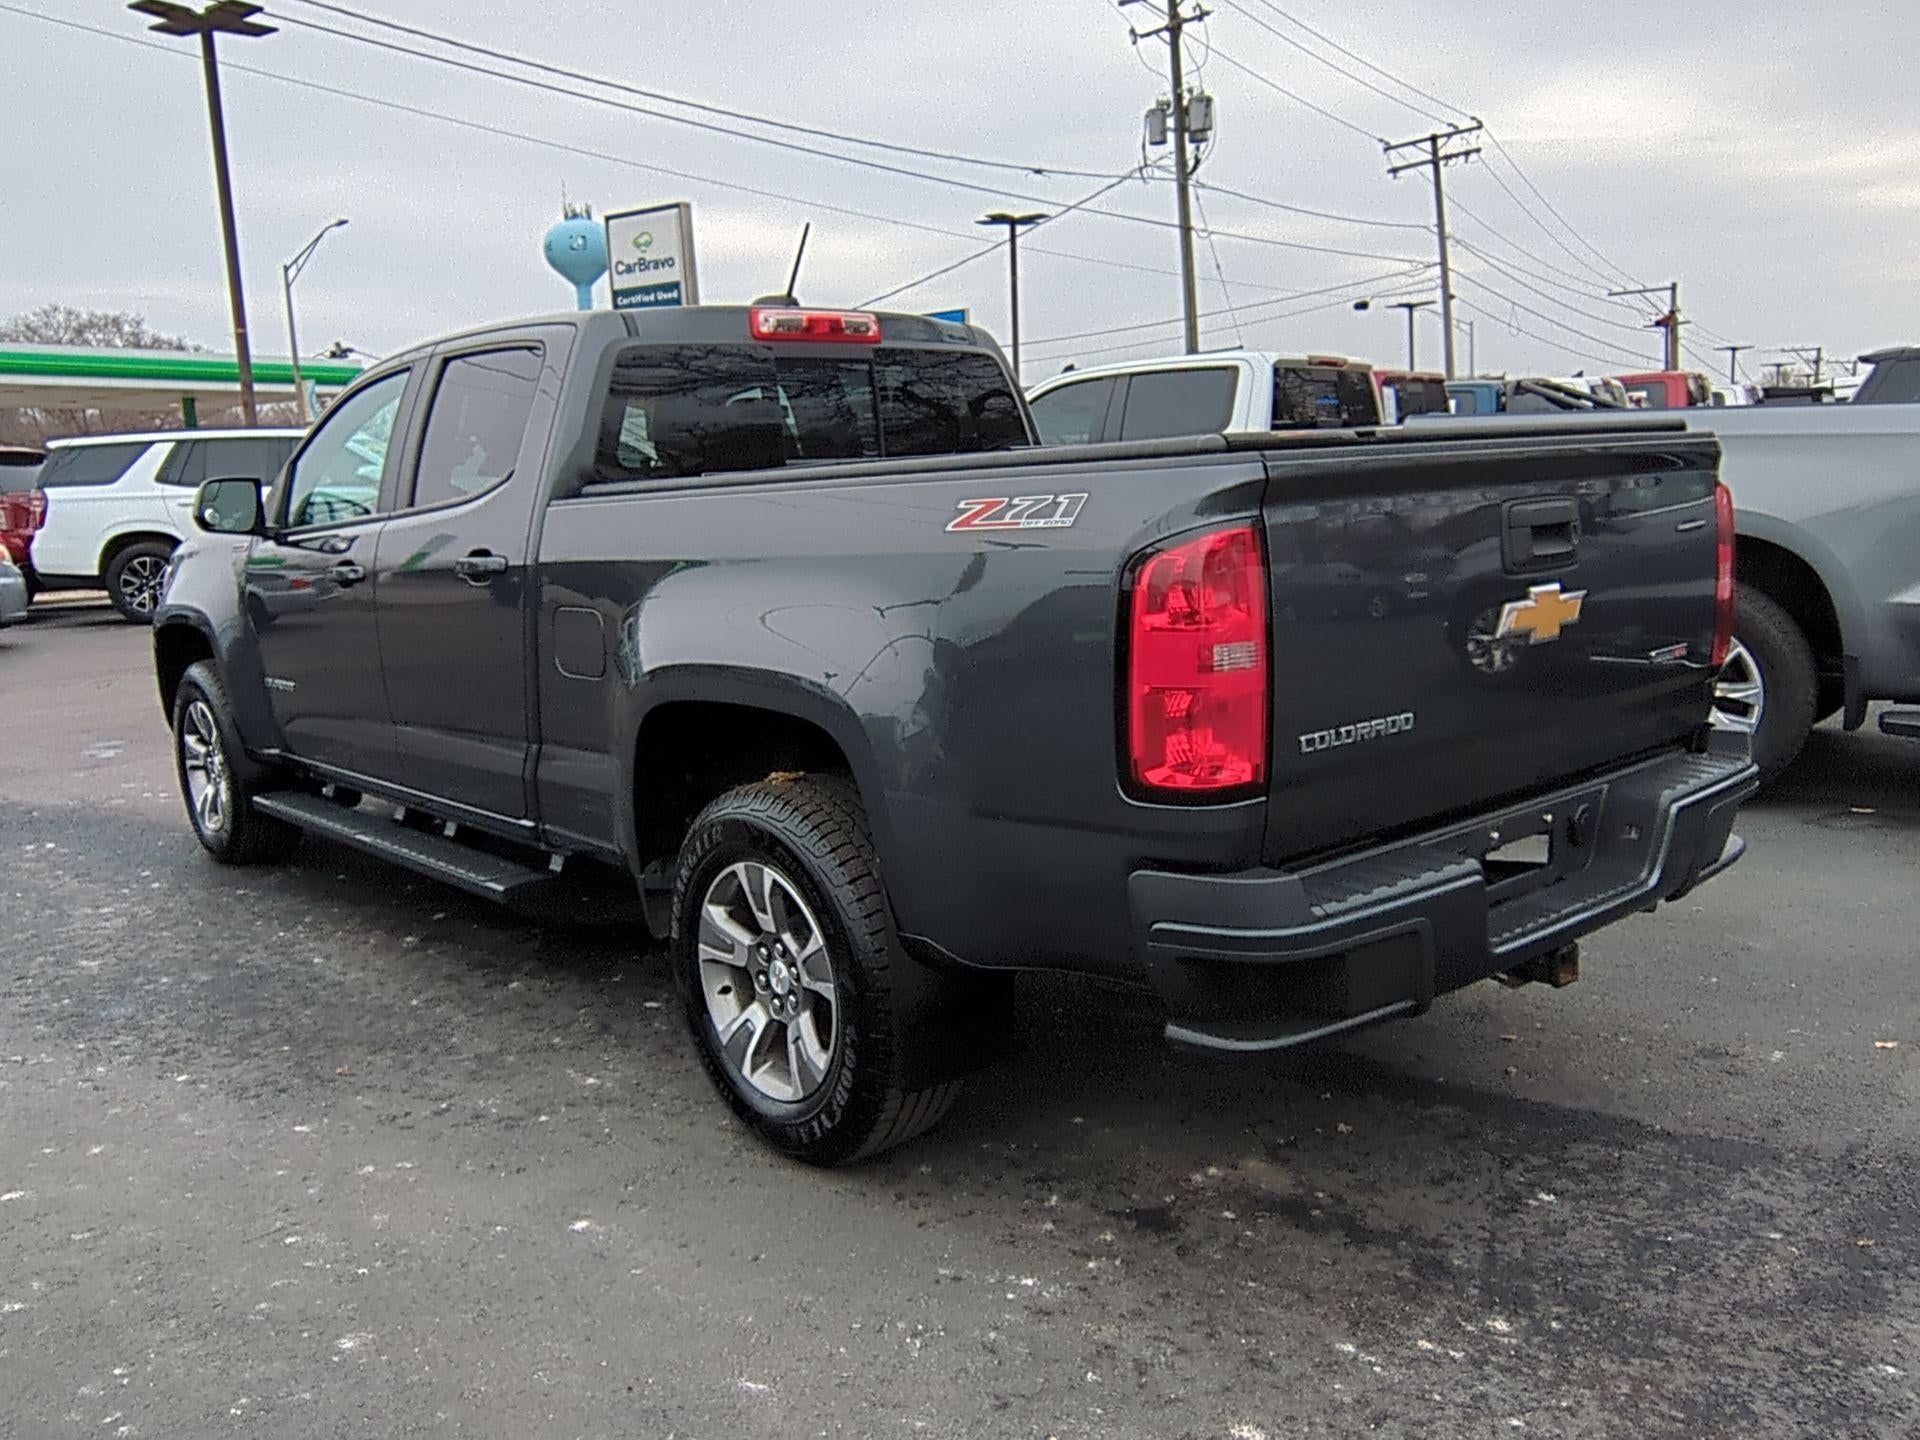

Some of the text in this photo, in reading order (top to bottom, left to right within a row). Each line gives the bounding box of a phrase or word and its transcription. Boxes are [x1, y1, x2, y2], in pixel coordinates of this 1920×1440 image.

[615, 257, 675, 275] CarBravo
[616, 288, 679, 306] Certified Used
[945, 493, 1089, 531] Z71
[1299, 712, 1414, 753] COLORADO
